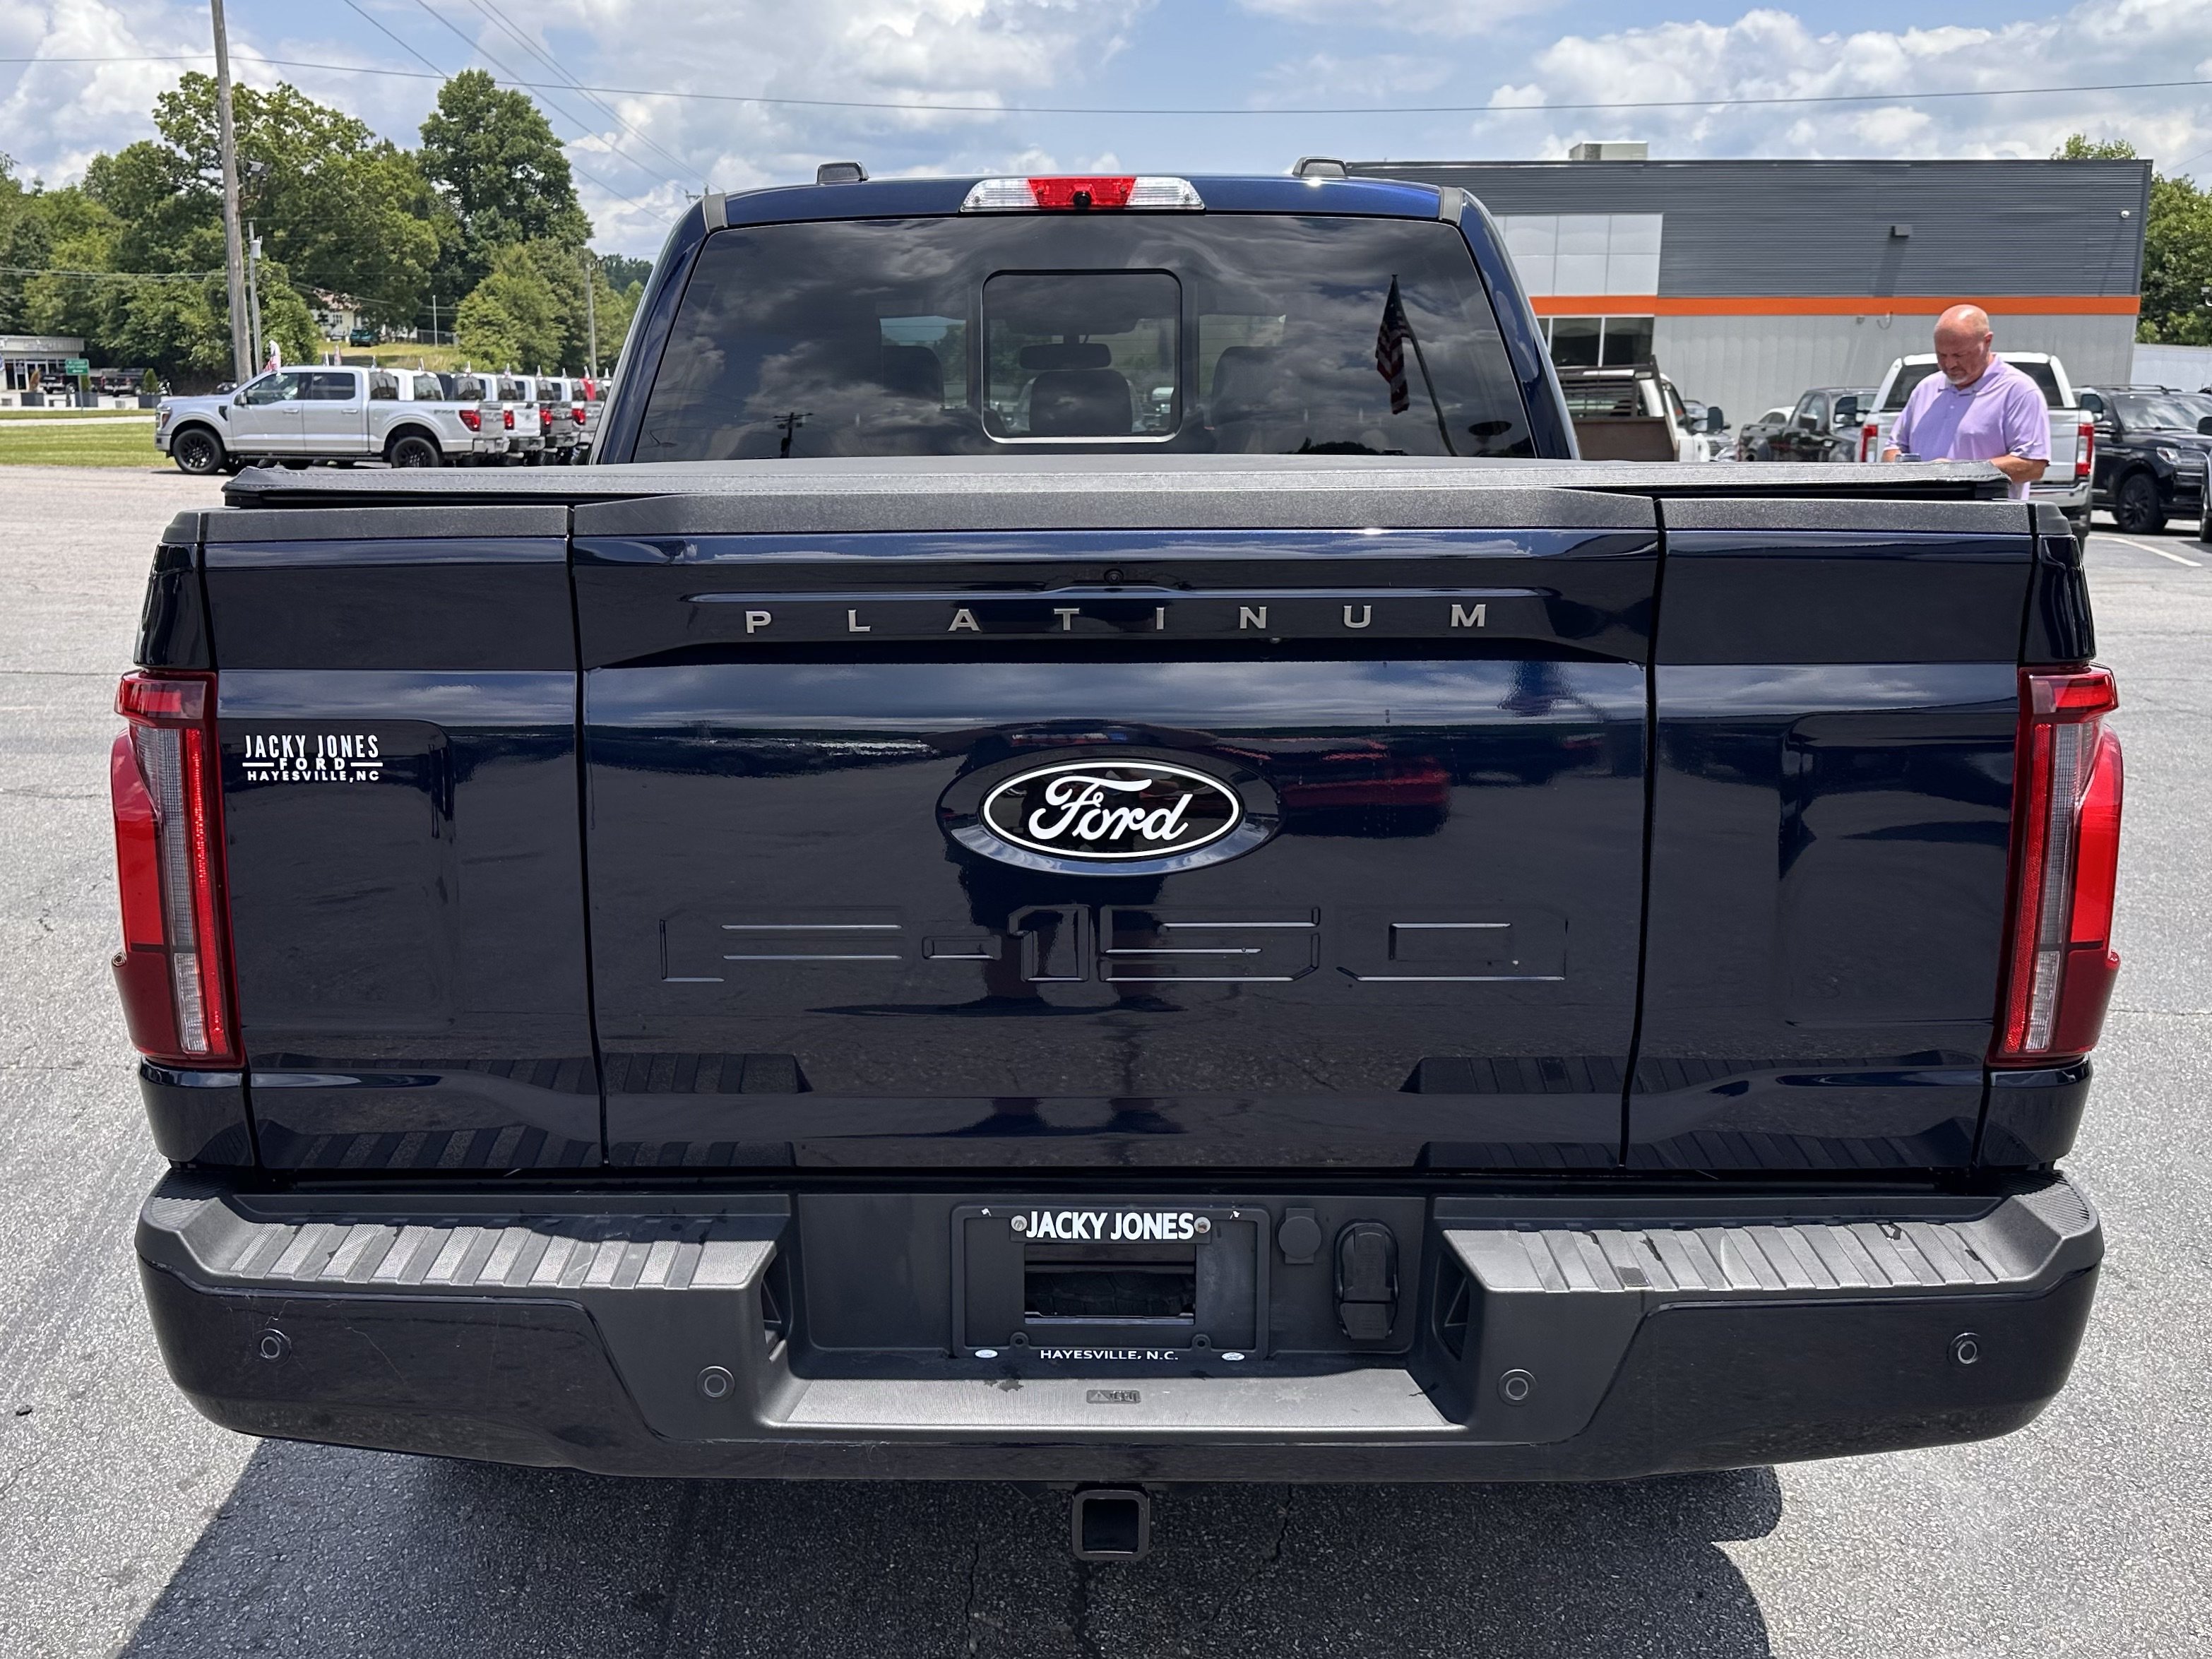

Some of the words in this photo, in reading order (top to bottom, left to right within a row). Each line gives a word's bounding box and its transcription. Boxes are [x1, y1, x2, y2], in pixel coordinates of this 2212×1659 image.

[745, 604, 1487, 634] PLATINUM
[245, 735, 306, 758] JACKY
[317, 735, 379, 758] JONES
[279, 757, 345, 771] FORD
[1028, 775, 1194, 840] Ford
[1025, 1211, 1108, 1239] JACKY
[1110, 1212, 1194, 1240] JONES
[1040, 1350, 1142, 1360] HAYESVILLE,
[1146, 1350, 1179, 1360] N.C.
